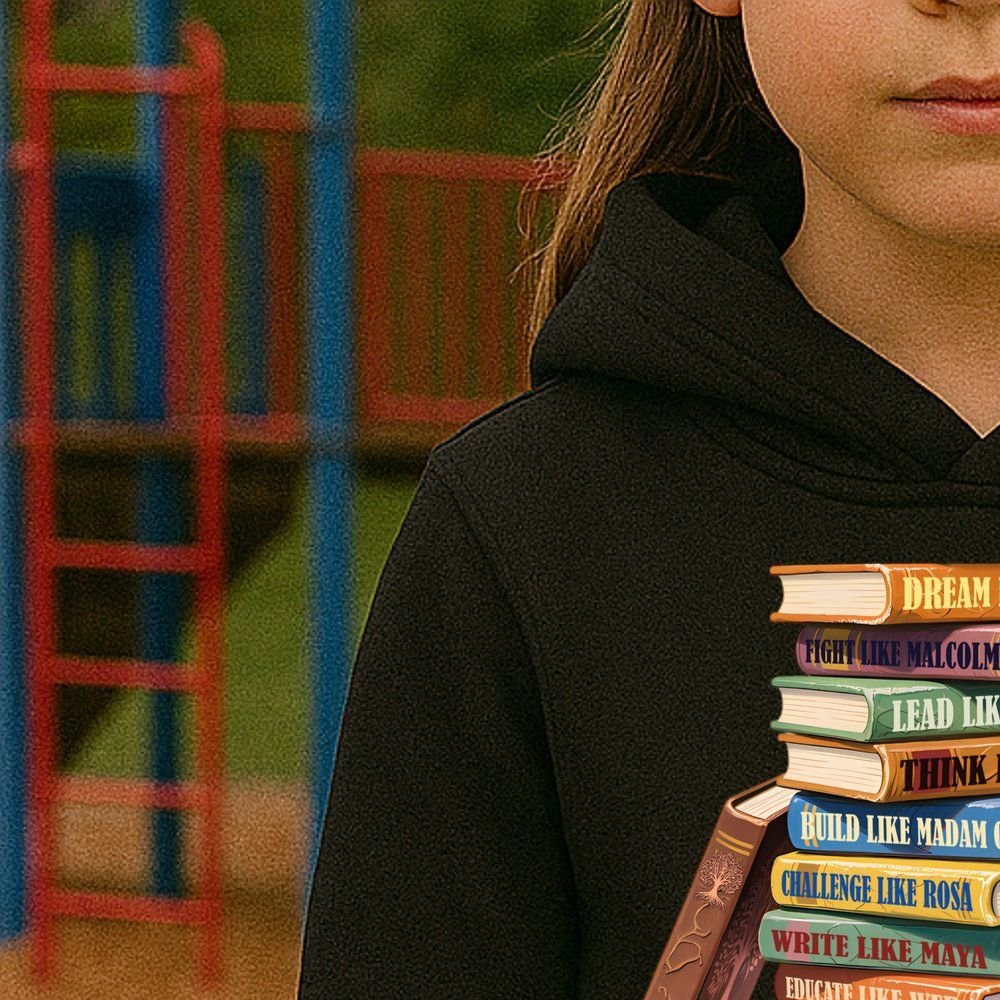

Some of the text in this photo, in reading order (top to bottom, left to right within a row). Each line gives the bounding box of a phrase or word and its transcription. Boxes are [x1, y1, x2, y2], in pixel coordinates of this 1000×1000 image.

[902, 576, 991, 611] DREAM
[804, 638, 1000, 671] FIGHT LIKE MALCOLM
[891, 698, 954, 734] LEAD
[900, 753, 988, 792] THINK
[800, 810, 860, 843] BUILD
[866, 815, 911, 846] LIKE
[916, 817, 988, 849] MADAM
[781, 869, 973, 912] CHALLENGE LIKE ROSA
[771, 929, 988, 970] WRITE LIKE MAYA
